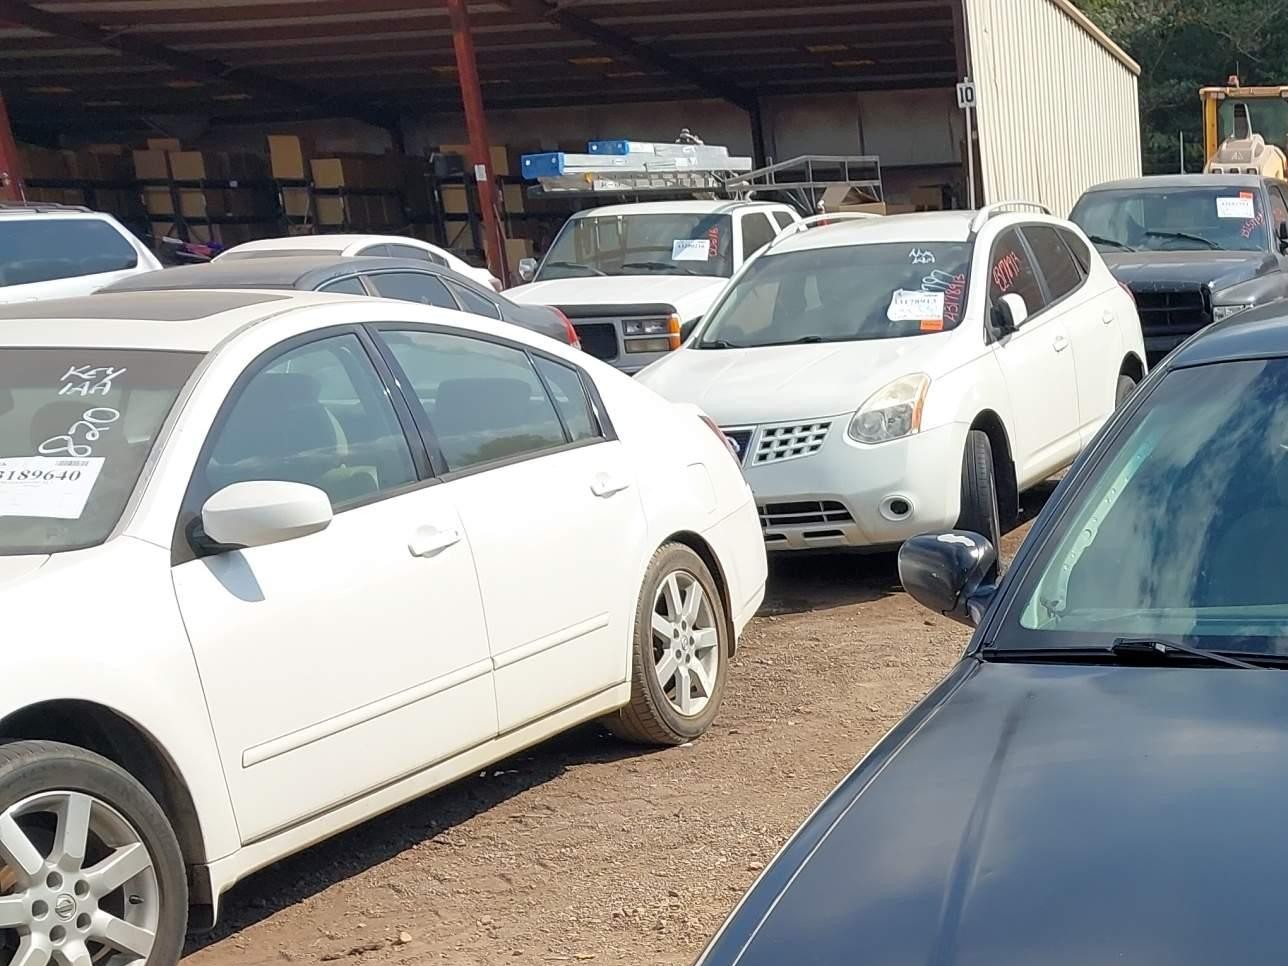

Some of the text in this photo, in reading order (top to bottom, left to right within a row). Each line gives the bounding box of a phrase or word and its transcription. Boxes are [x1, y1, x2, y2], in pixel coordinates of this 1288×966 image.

[959, 86, 974, 103] 10
[60, 364, 127, 382] KEY
[38, 407, 120, 458] 820
